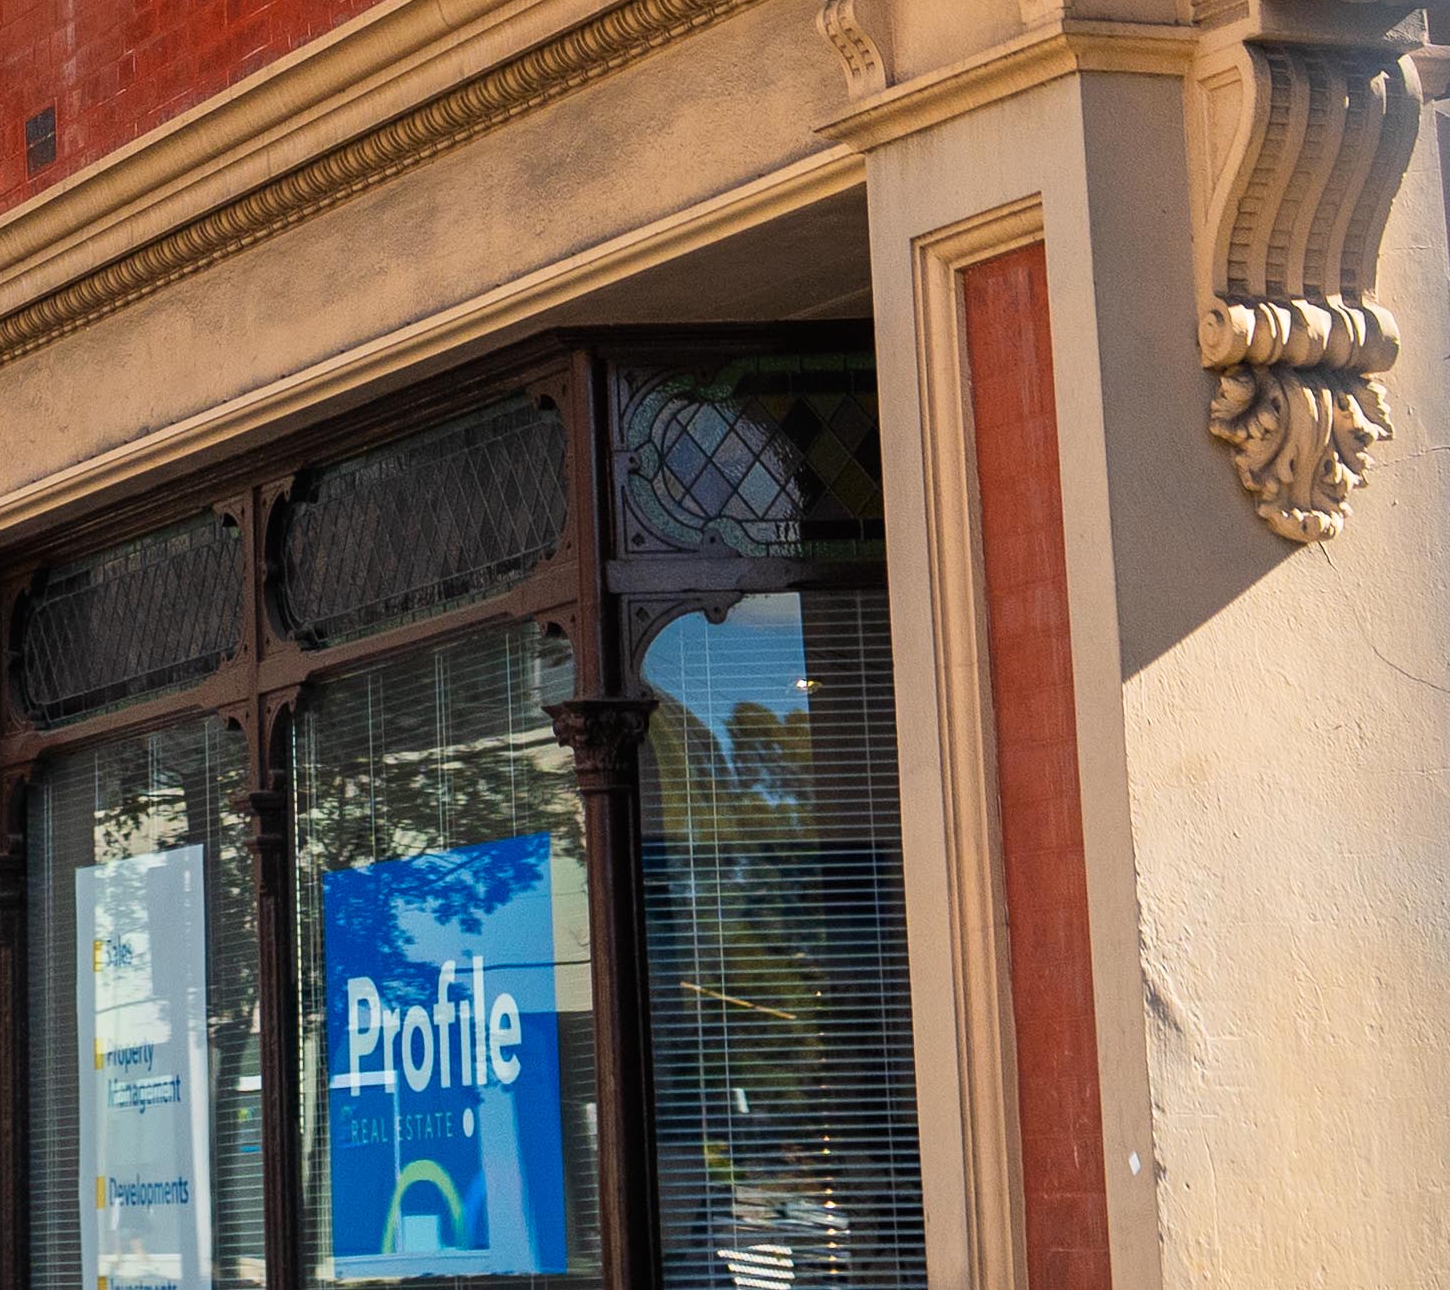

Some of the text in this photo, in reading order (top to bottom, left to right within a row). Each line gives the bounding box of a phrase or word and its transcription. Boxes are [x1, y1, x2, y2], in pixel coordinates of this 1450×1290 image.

[347, 955, 522, 1097] Profile
[351, 1112, 454, 1144] REAL ESTATE
[109, 1173, 189, 1210] Developments
